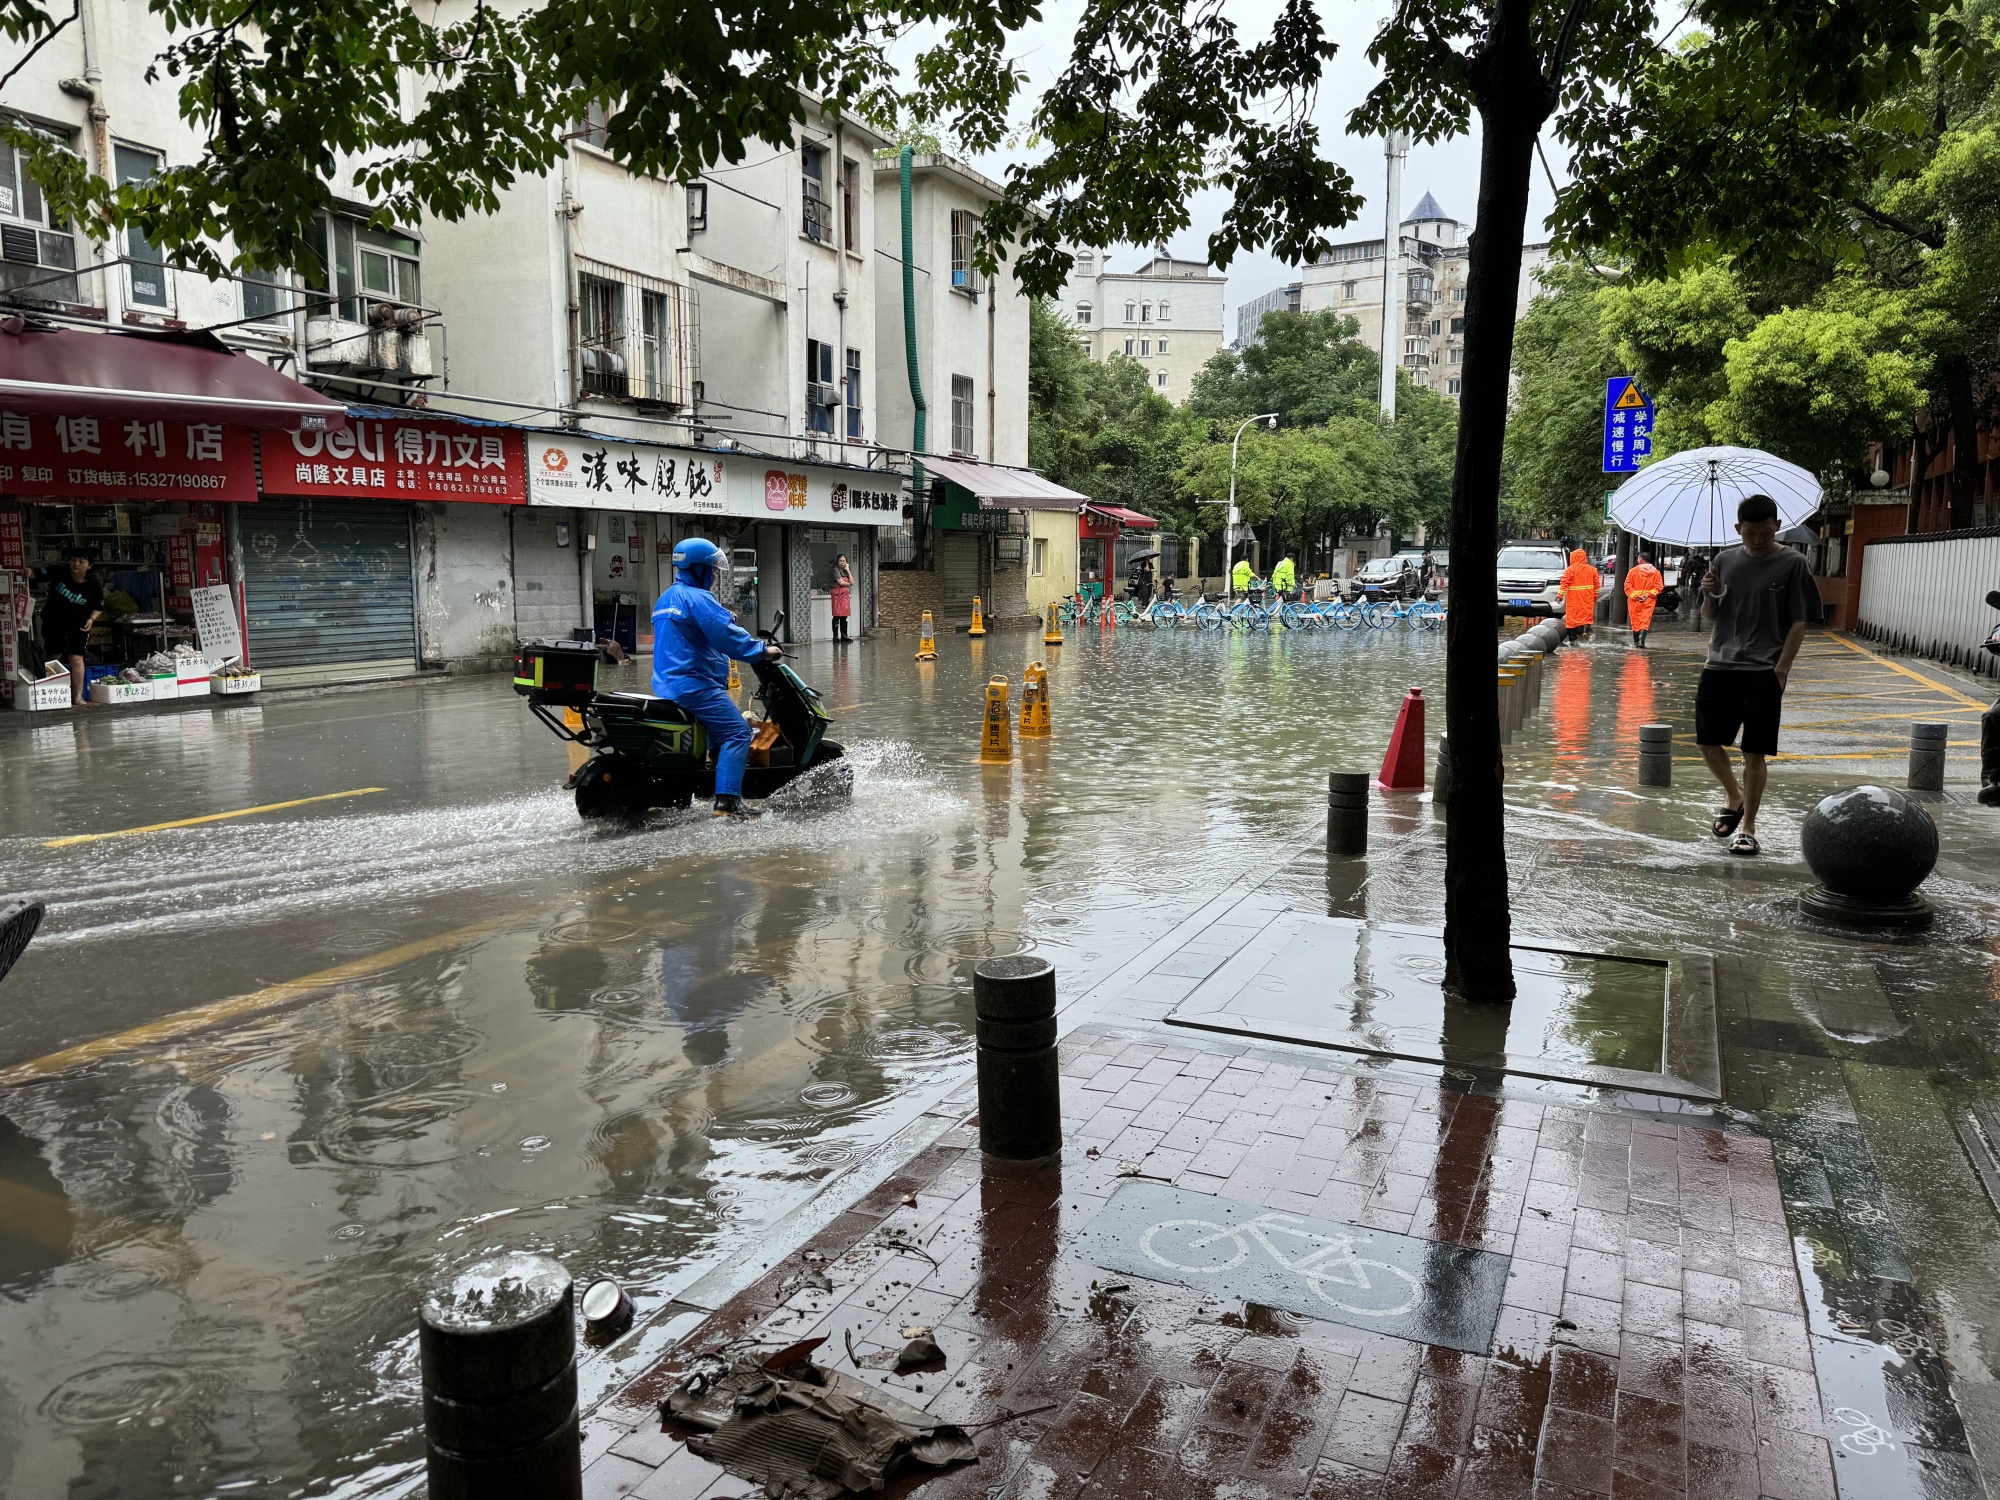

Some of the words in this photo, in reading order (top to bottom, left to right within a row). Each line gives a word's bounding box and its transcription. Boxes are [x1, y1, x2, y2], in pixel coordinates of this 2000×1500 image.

[1625, 393, 1636, 404] 慢
[1610, 412, 1626, 467] 减速慢行
[1632, 410, 1648, 466] 学校周边
[395, 427, 506, 471] 得力文具
[21, 466, 53, 483] 复印
[295, 463, 386, 488] 尚隆文具店
[427, 470, 462, 482] 学生用品
[472, 473, 507, 485] 办公用品
[428, 482, 507, 495] 18062579863
[1, 512, 18, 525] 复印
[1, 526, 19, 539] 过塑
[2, 541, 20, 553] 彩印
[171, 537, 187, 547] 复印
[4, 554, 22, 567] 扫描
[171, 549, 188, 559] 过塑
[173, 562, 189, 572] 彩印
[174, 574, 190, 584] 扫描
